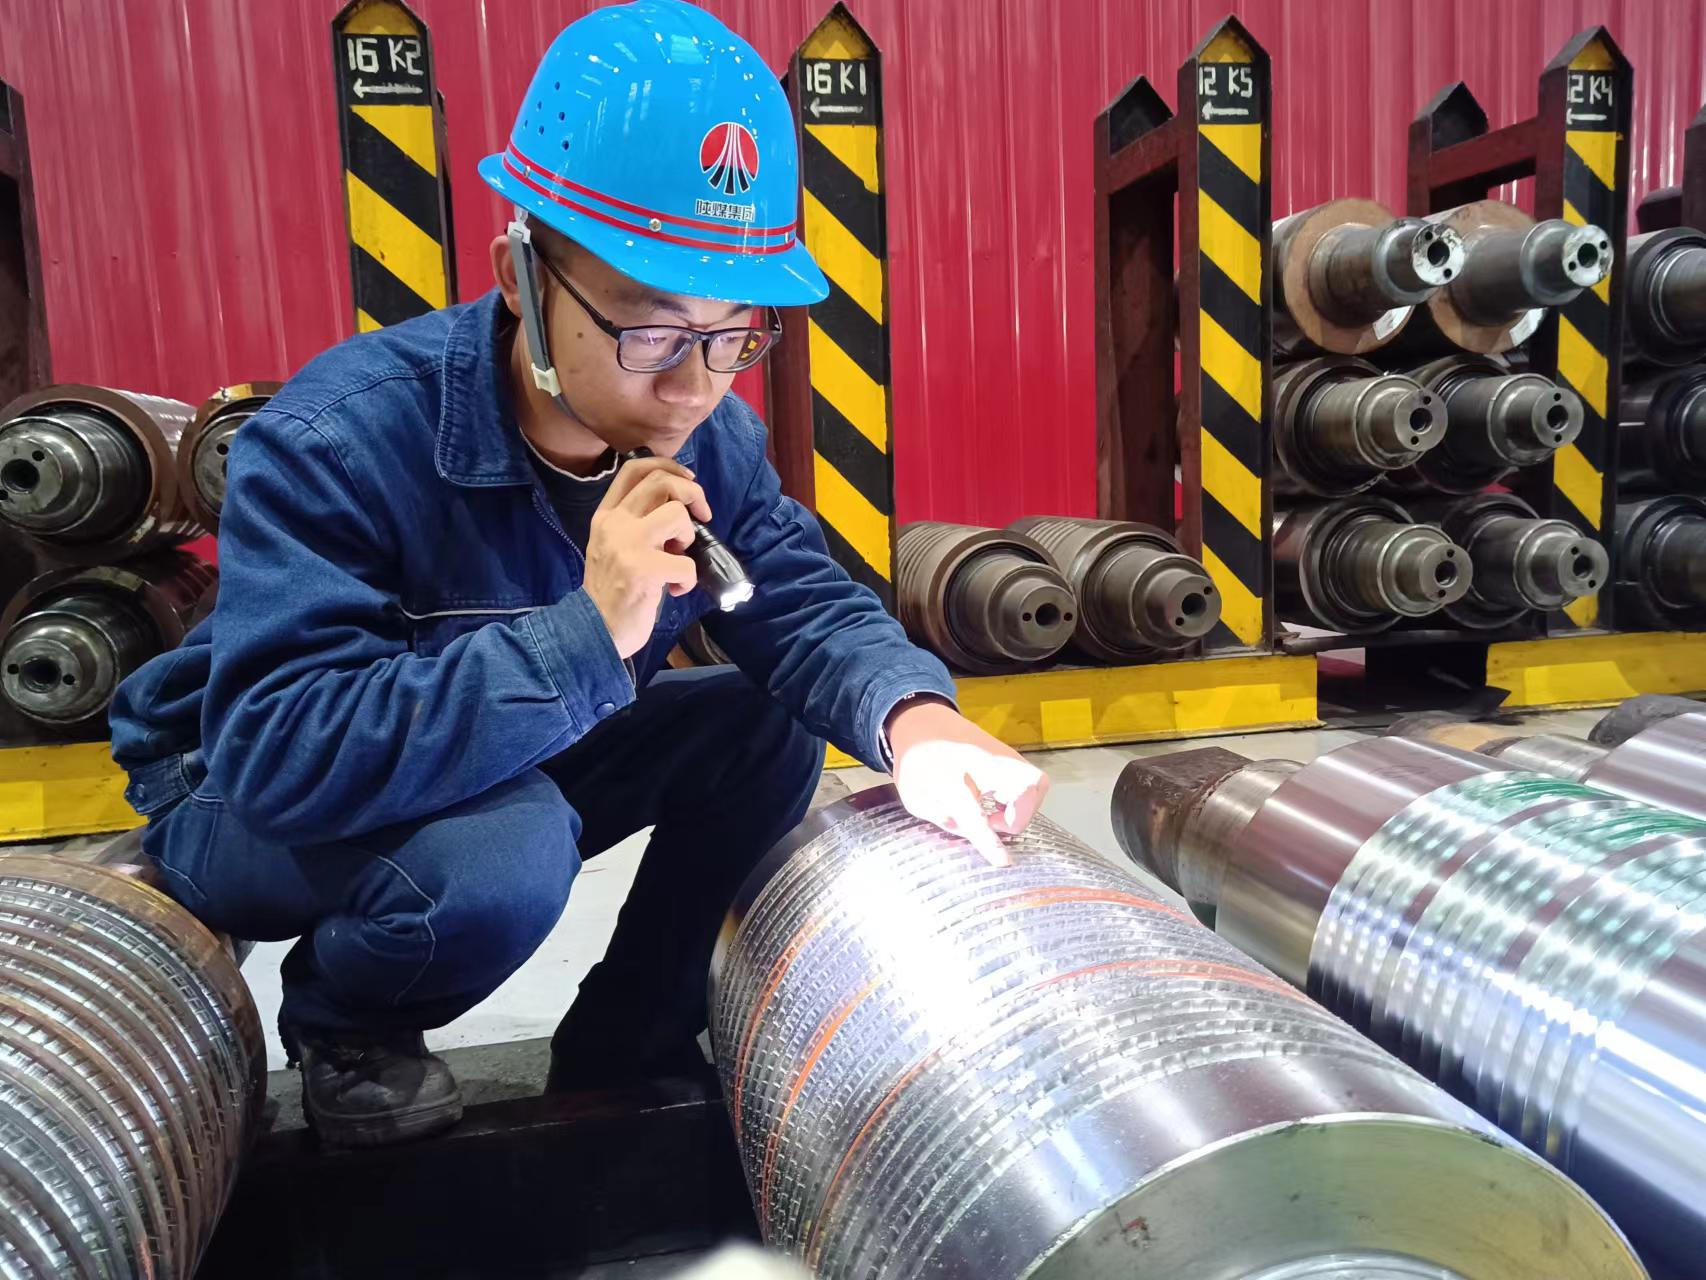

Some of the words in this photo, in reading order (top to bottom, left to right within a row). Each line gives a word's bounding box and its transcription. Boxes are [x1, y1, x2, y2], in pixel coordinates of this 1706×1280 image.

[347, 38, 379, 73] 16
[388, 38, 423, 75] K2
[806, 62, 831, 94] 16
[1199, 67, 1217, 95] 12
[1229, 66, 1252, 98] K5
[1590, 76, 1612, 106] K4
